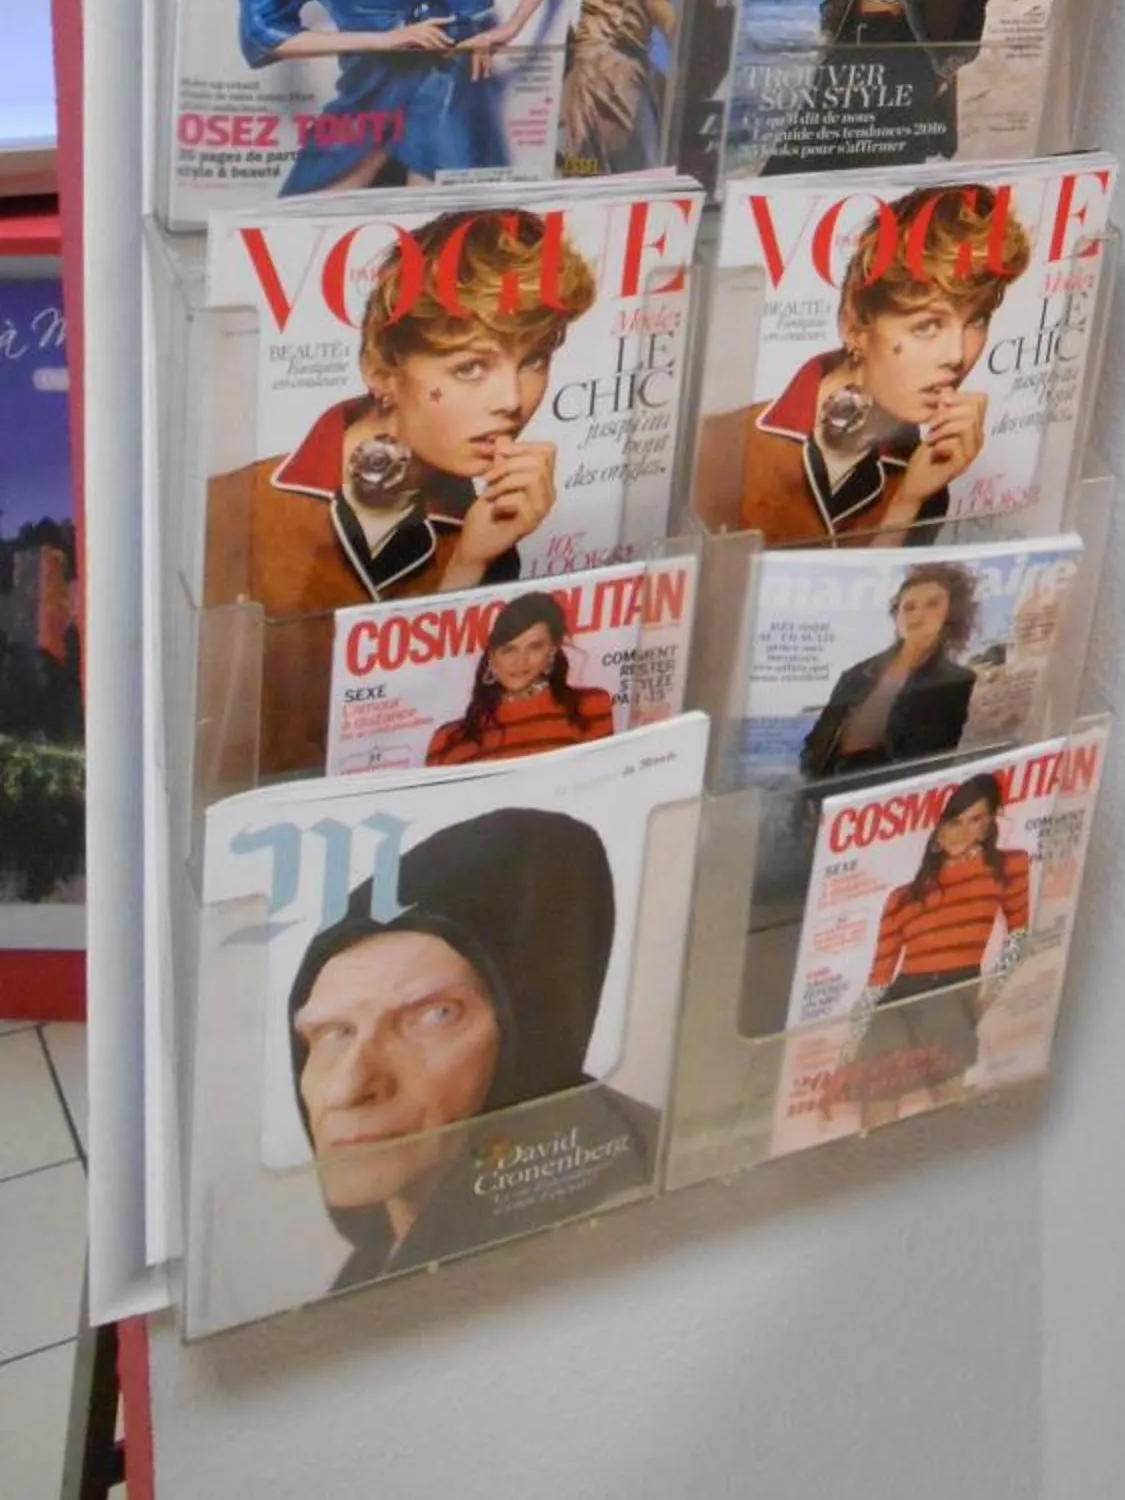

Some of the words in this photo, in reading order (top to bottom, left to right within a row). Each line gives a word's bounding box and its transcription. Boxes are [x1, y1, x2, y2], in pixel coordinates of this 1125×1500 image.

[746, 63, 886, 90] TROUVER
[759, 84, 819, 111] SON
[821, 83, 914, 109] STYLE
[177, 111, 280, 148] OSEZ
[799, 111, 820, 125] dit
[823, 112, 840, 124] de
[816, 125, 842, 140] des
[201, 151, 244, 168] pages
[246, 151, 265, 164] de
[231, 165, 281, 179] beauté
[748, 169, 1110, 292] VOGUE
[236, 199, 695, 334] VOGUE
[1038, 293, 1088, 332] LE
[617, 329, 675, 373] LE
[987, 328, 1085, 375] CHIC
[552, 369, 674, 423] CHIC
[345, 568, 687, 677] COSMLITAN
[601, 644, 678, 669] COMMENT
[344, 683, 388, 704] SEXE
[829, 745, 1098, 855] COSMLITAN
